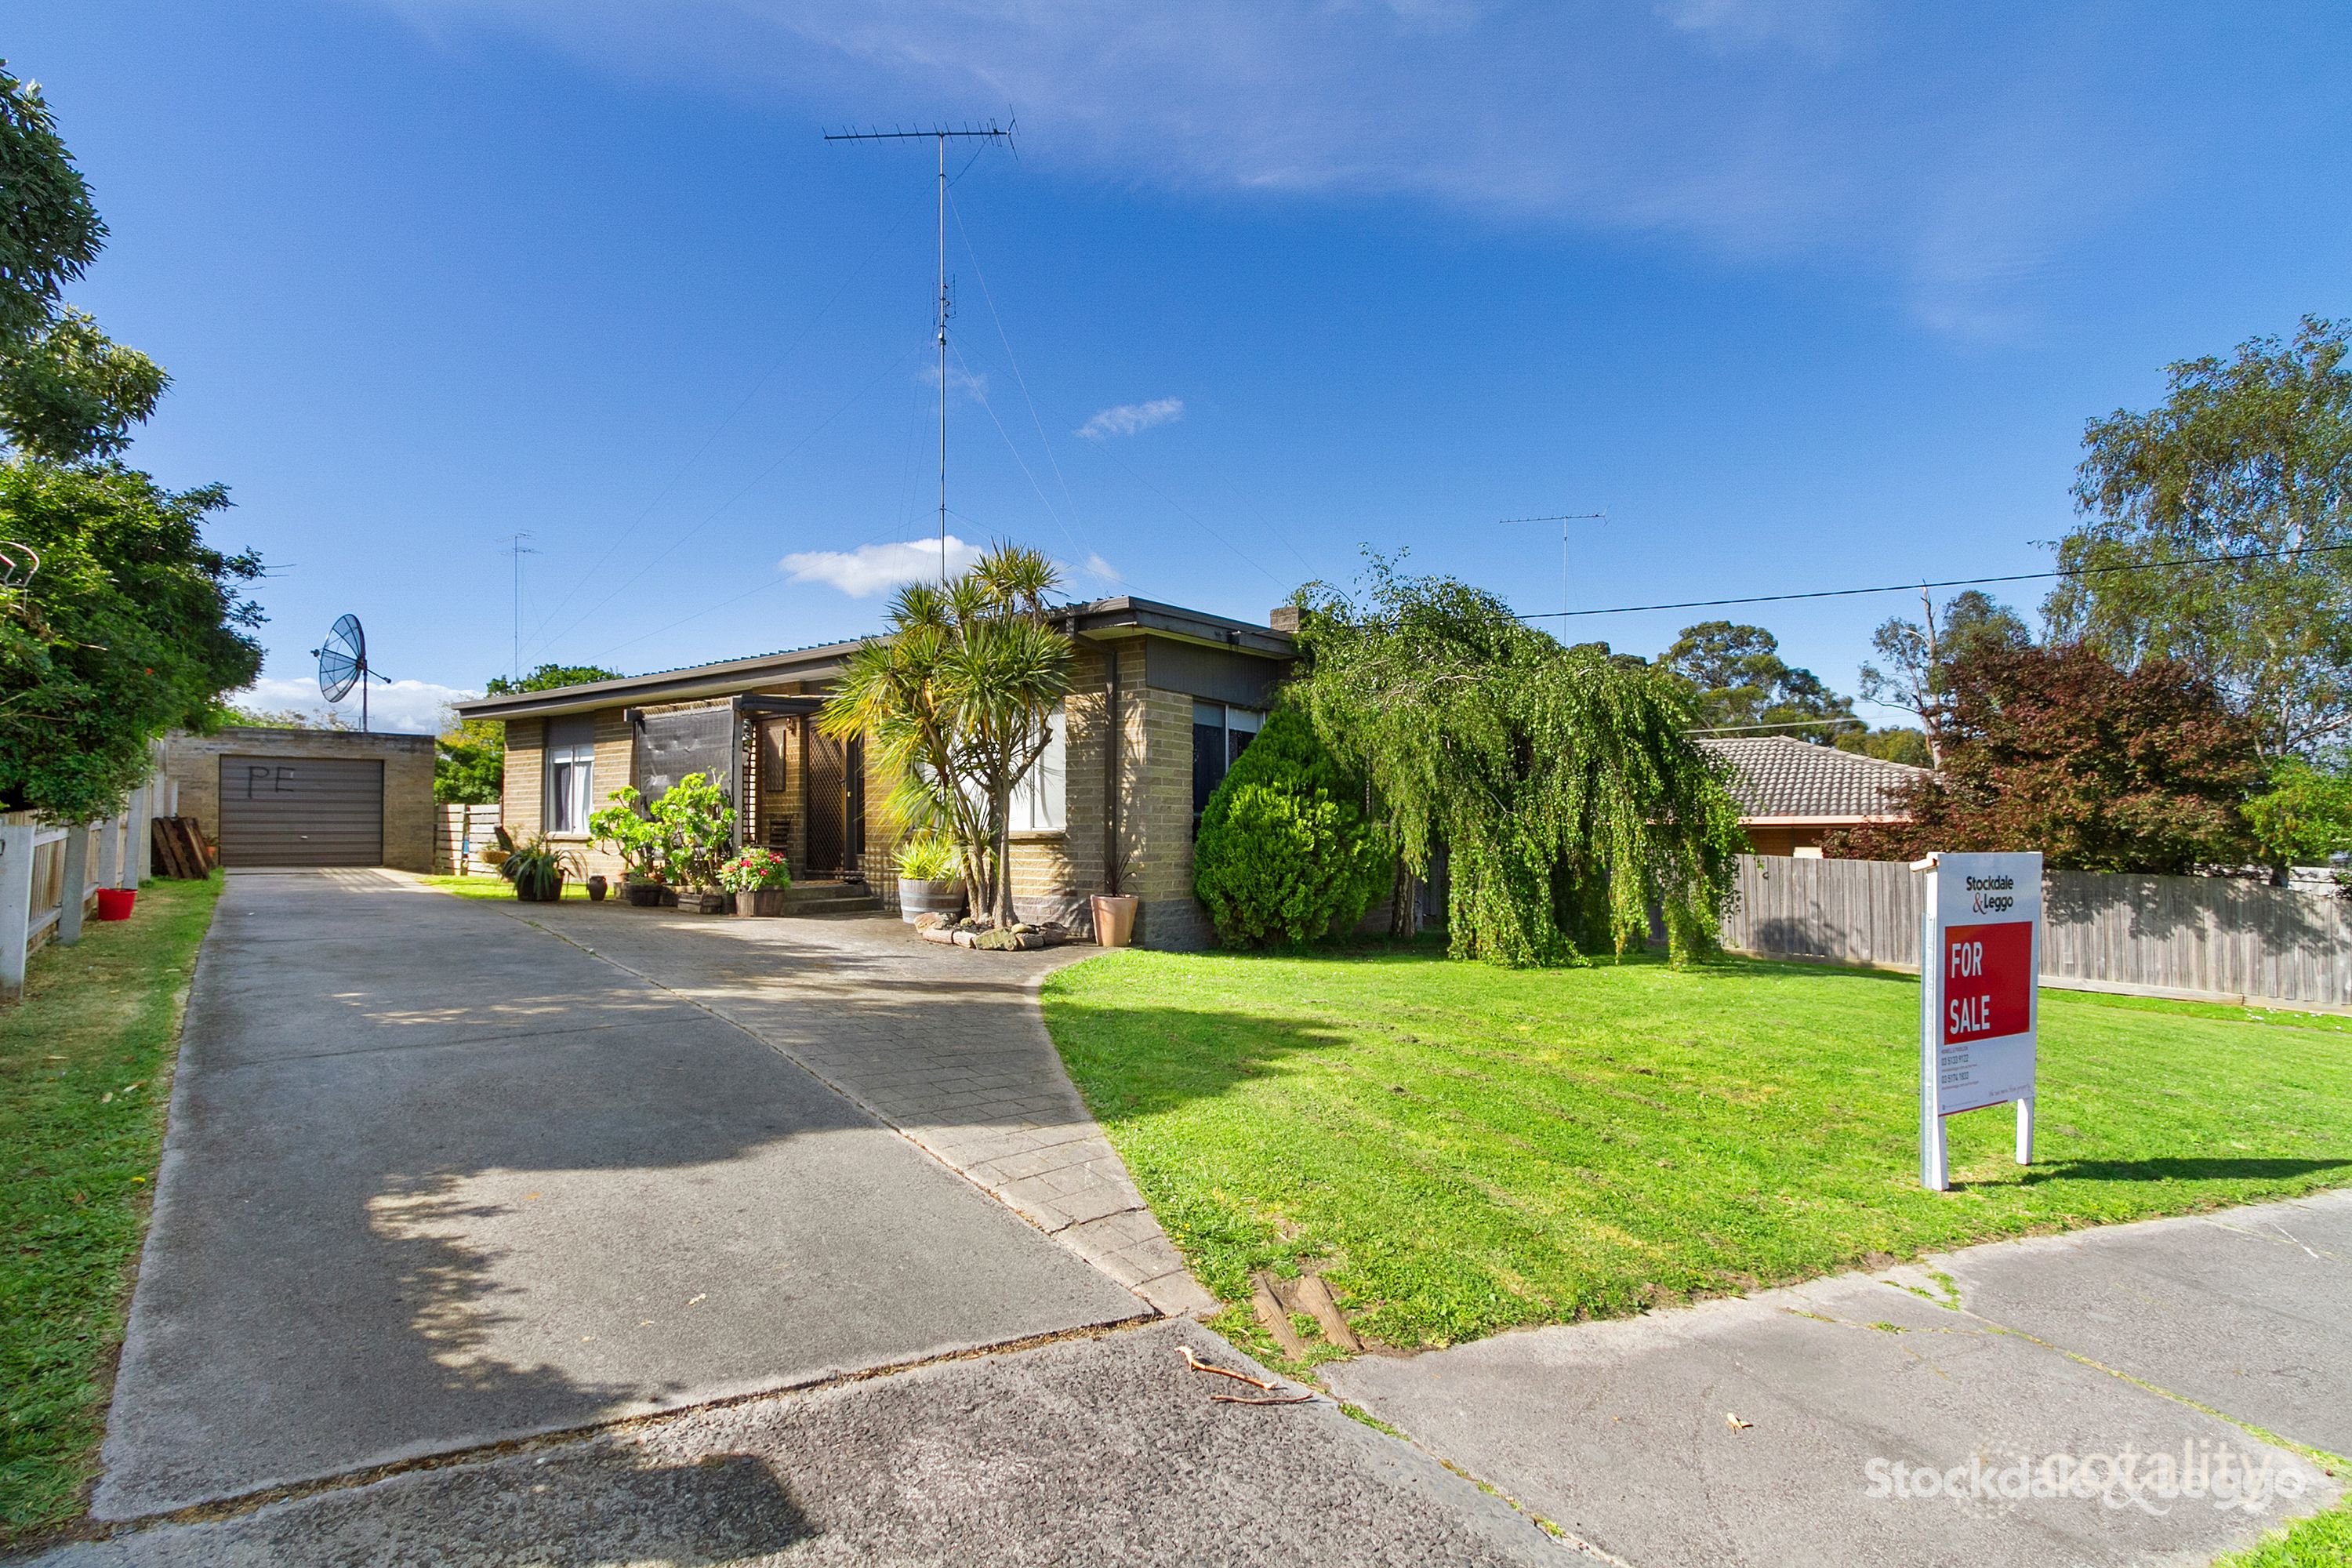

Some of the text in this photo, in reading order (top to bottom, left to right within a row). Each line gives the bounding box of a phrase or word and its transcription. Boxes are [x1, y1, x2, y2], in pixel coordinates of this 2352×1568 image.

[1966, 875, 2014, 891] Stockdale
[1951, 941, 1984, 979] FOR
[1949, 994, 1991, 1035] SALE
